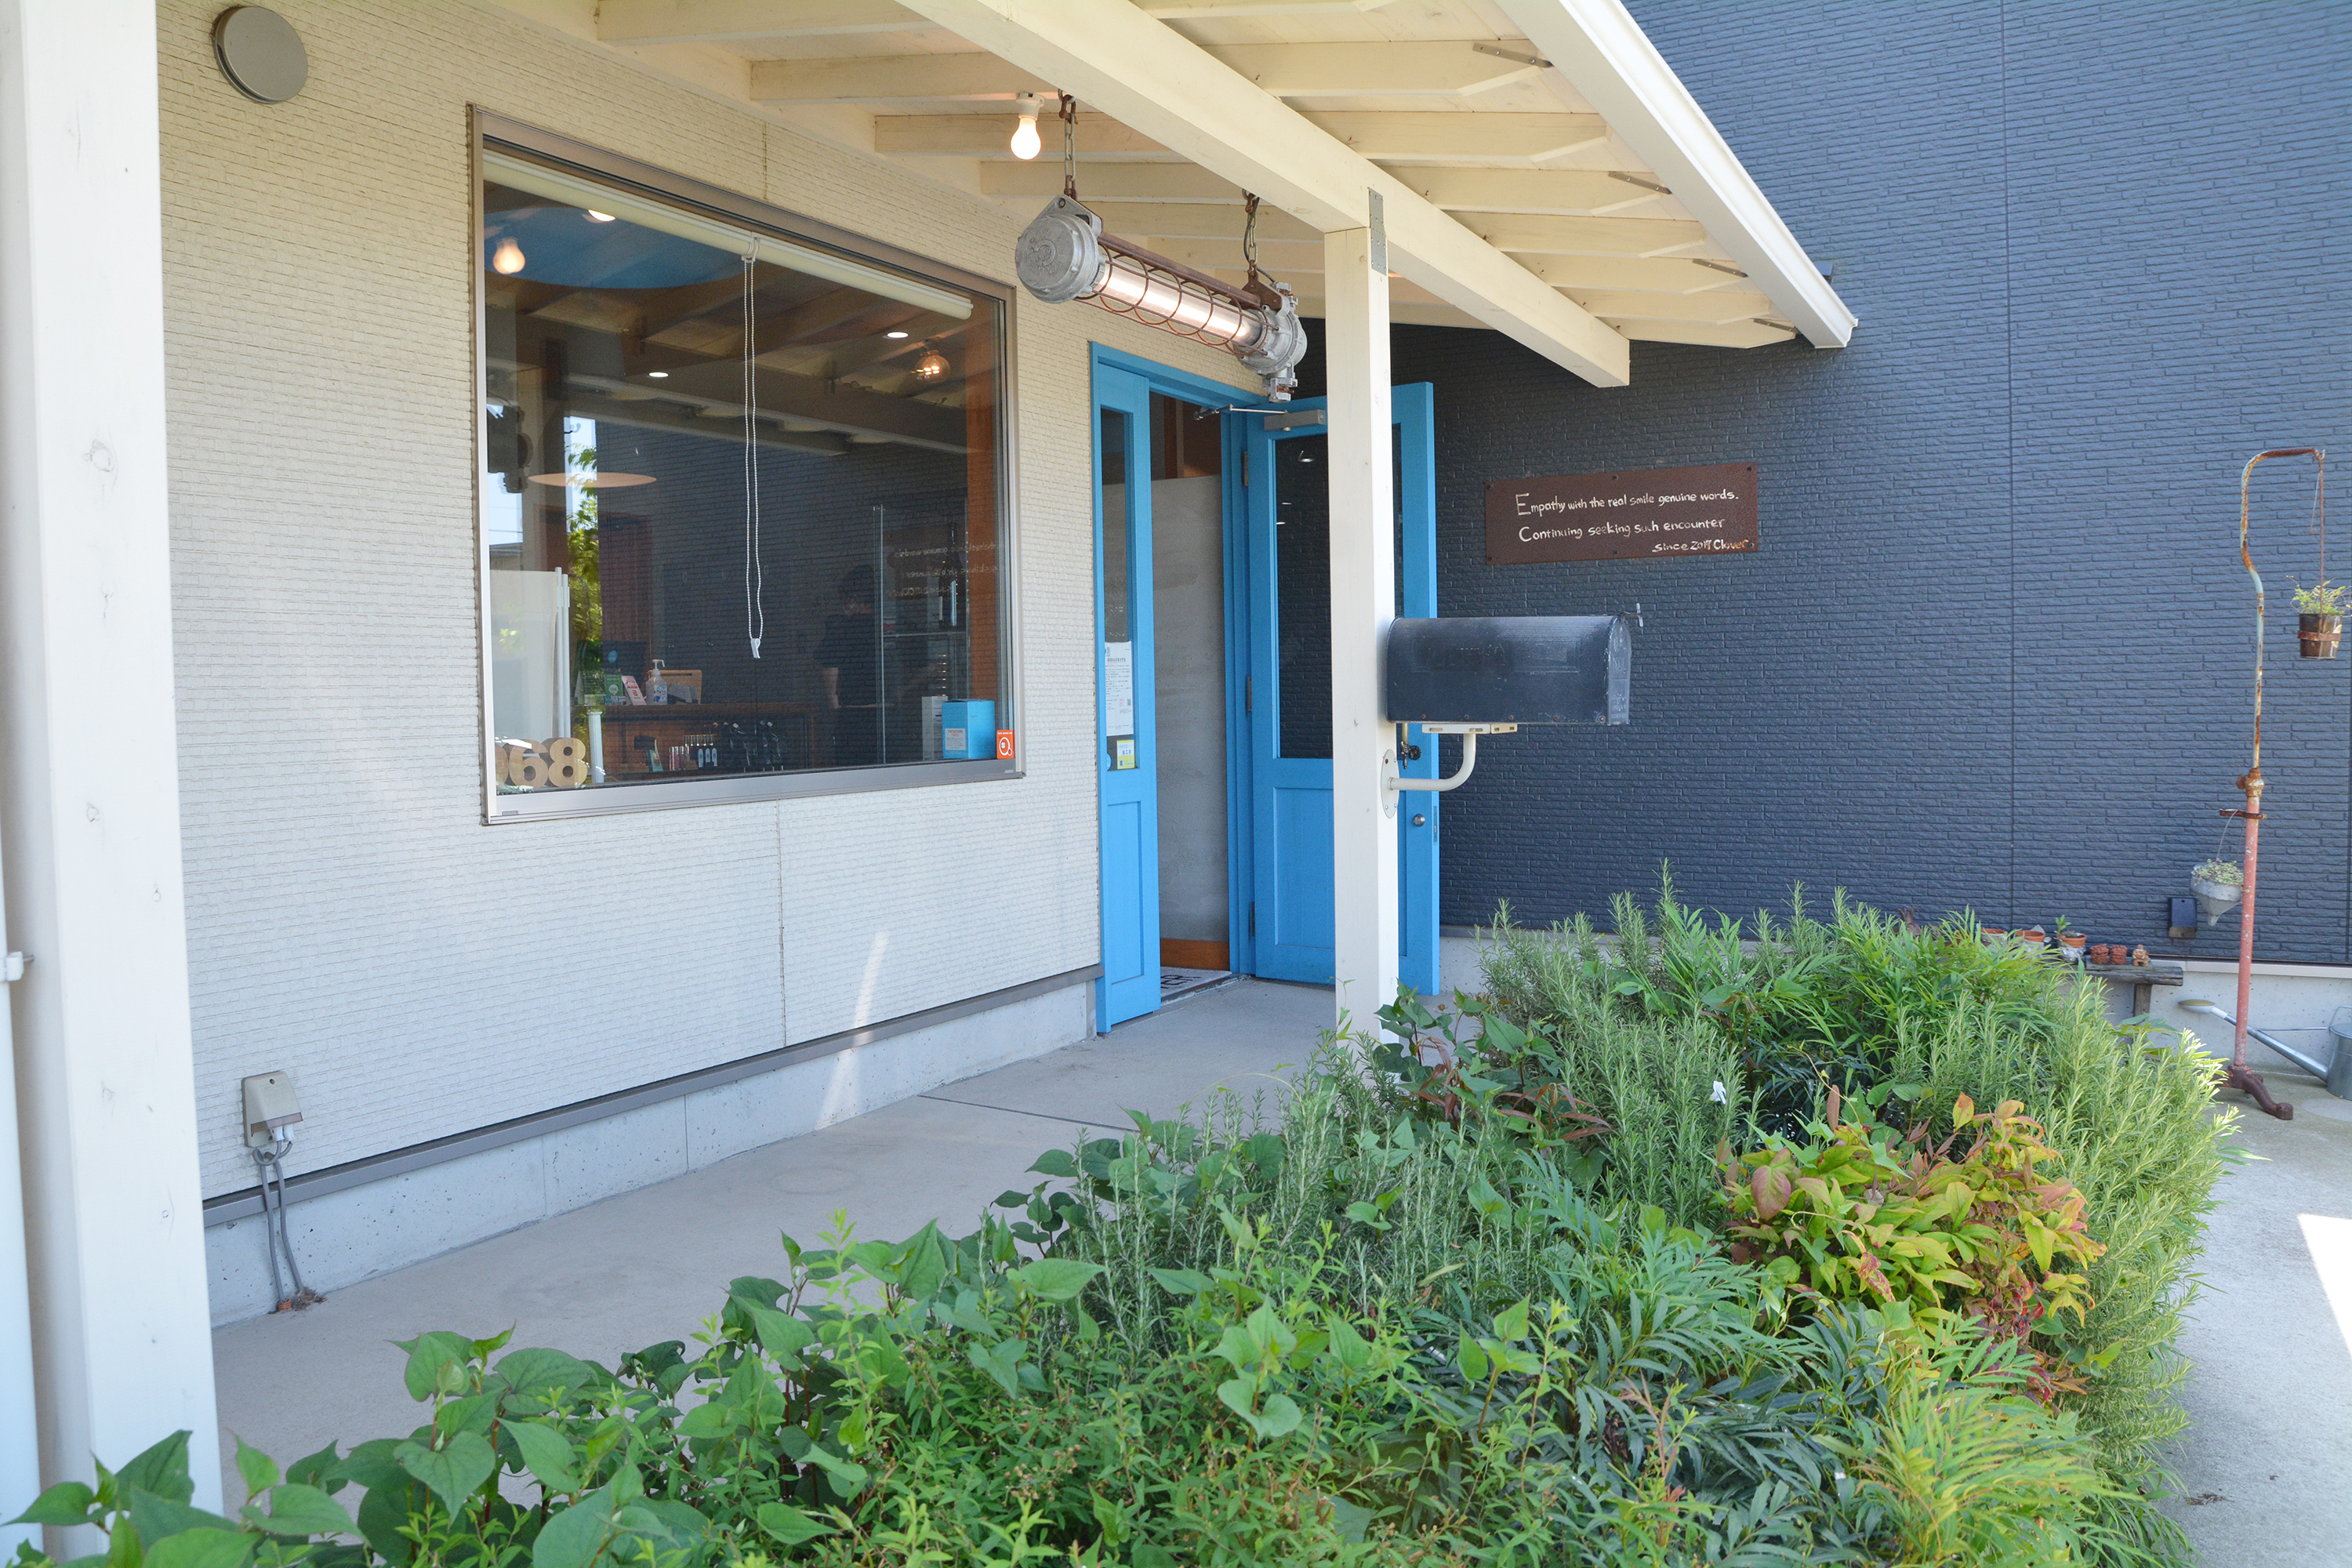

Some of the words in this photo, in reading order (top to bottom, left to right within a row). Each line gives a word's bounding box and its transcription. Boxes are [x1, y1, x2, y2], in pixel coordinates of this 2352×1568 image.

[1515, 492, 1566, 517] Empathy
[1567, 499, 1588, 510] with
[1589, 496, 1605, 508] the
[1607, 494, 1627, 507] real
[1629, 492, 1655, 506] smile
[1657, 493, 1697, 506] genuine
[1700, 488, 1739, 500] words.
[1519, 526, 1583, 542] Continuing
[1588, 521, 1631, 538] seeking
[1663, 519, 1725, 531] encounter
